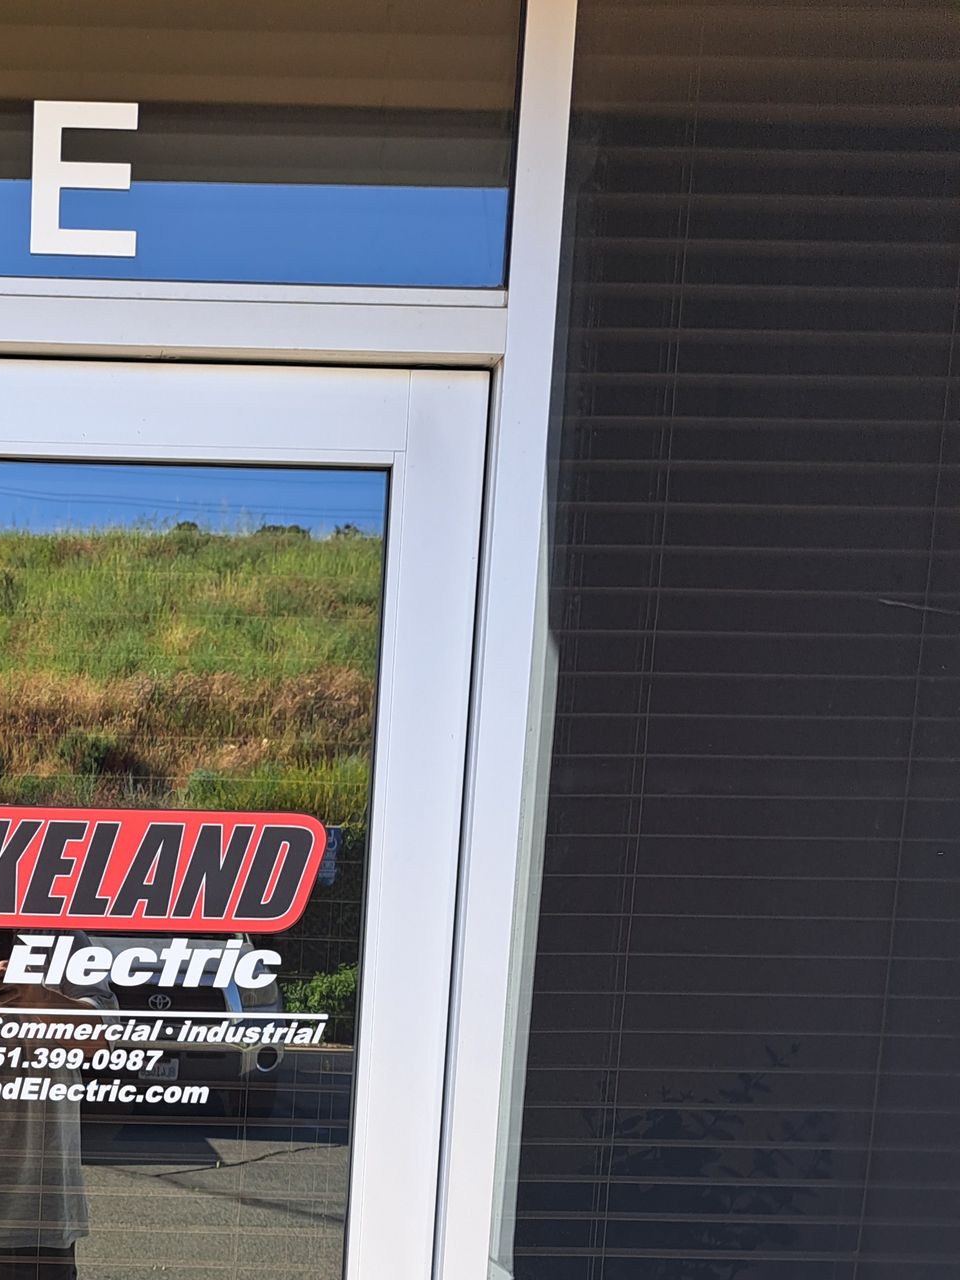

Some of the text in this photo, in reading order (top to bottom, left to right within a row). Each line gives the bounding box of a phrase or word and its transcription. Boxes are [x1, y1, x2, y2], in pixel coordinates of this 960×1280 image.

[30, 100, 139, 257] E
[3, 934, 282, 989] Electric
[177, 1020, 326, 1045] Industrial
